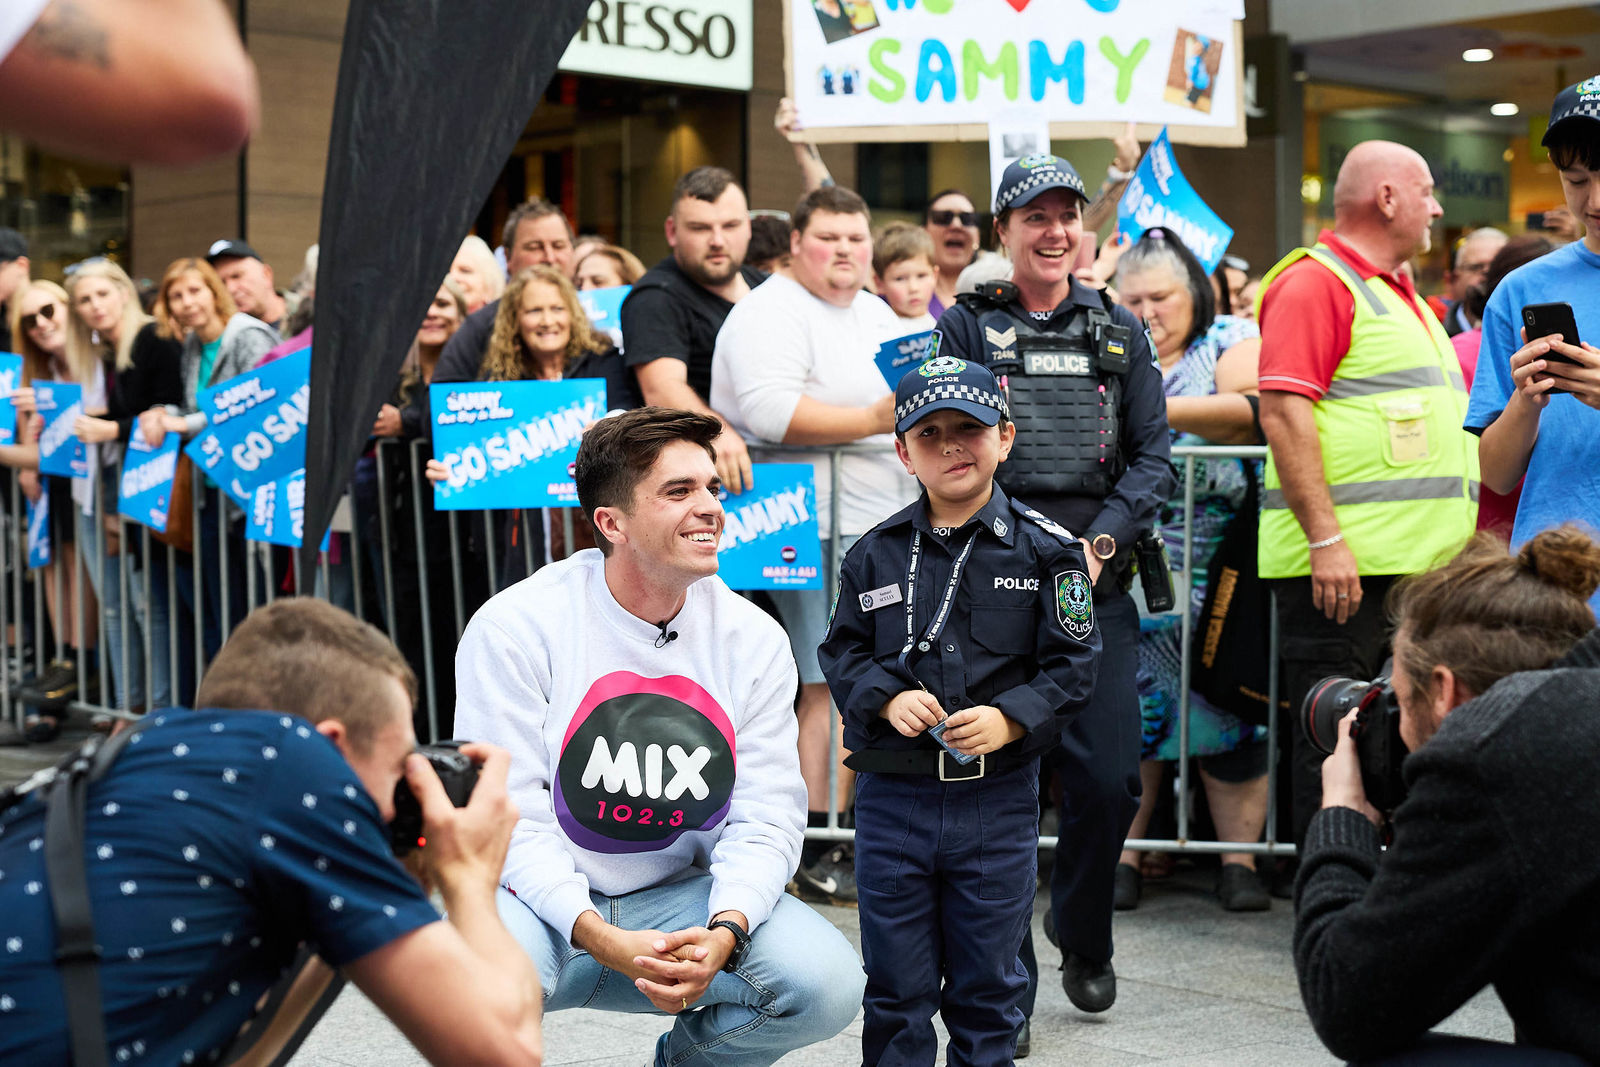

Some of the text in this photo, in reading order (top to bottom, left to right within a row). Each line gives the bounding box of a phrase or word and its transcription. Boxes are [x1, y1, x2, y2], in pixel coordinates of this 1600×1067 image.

[868, 36, 1150, 104] SAMMY
[928, 376, 959, 385] POLICE
[1031, 355, 1090, 373] POLICE
[232, 431, 274, 472] GO
[443, 402, 596, 488] GO SAMMY
[717, 486, 810, 553] AMMY
[994, 577, 1039, 591] POLICE
[1063, 616, 1093, 633] POLICE
[581, 736, 711, 800] MIX
[597, 801, 684, 826] 102.3
